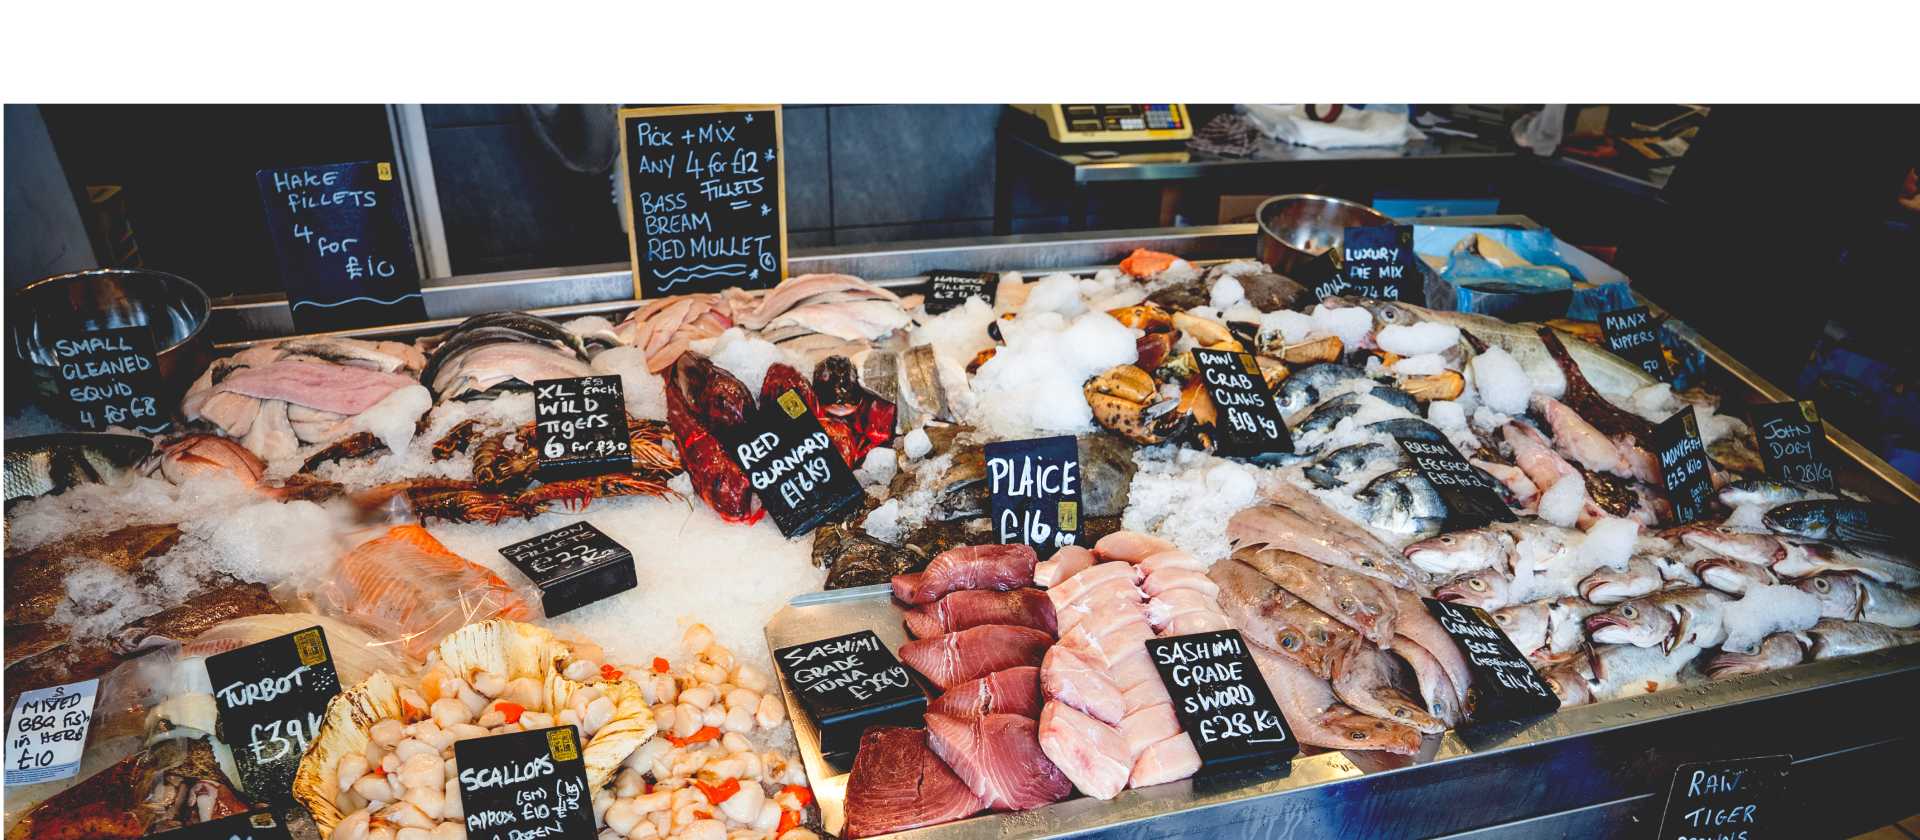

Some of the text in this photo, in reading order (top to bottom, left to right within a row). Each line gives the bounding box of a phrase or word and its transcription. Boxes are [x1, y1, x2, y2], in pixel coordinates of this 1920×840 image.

[640, 148, 758, 179] ANY 4 for £12
[640, 192, 687, 215] BASS
[294, 224, 313, 243] 4
[645, 212, 711, 235] BREAM
[318, 237, 357, 256] for
[648, 235, 771, 261] RED MULLET
[1345, 246, 1399, 261] LUXURY
[345, 256, 395, 280] £10
[1606, 313, 1647, 330] MANX
[56, 337, 133, 356] SMALL
[1610, 331, 1655, 350] KIPPERS
[63, 354, 151, 379] CLEANED
[1199, 352, 1236, 370] RAW!
[1206, 368, 1252, 389] CRAB
[537, 384, 576, 399] XL
[1216, 389, 1264, 407] CLAWS
[80, 410, 95, 428] 4
[131, 397, 156, 417] £8
[1763, 418, 1811, 439] JOHN
[544, 436, 564, 458] 6
[596, 440, 627, 456] £30
[737, 432, 779, 469] RED
[1403, 440, 1453, 456] BREAM
[751, 432, 829, 489] GURNARD
[502, 524, 584, 555] SALMON
[516, 531, 596, 561] FILLETS
[1441, 617, 1499, 639] CORNISH
[1465, 639, 1500, 655] SOLE
[794, 654, 864, 682] GRADE
[1172, 662, 1243, 687] GRADE
[216, 665, 311, 708] TURBOT
[804, 669, 868, 693] TUNA
[18, 715, 55, 732] BBQ
[17, 748, 54, 769] £10
[1688, 770, 1742, 797] RAW
[521, 803, 550, 820] £10
[1685, 804, 1756, 827] TIGER
